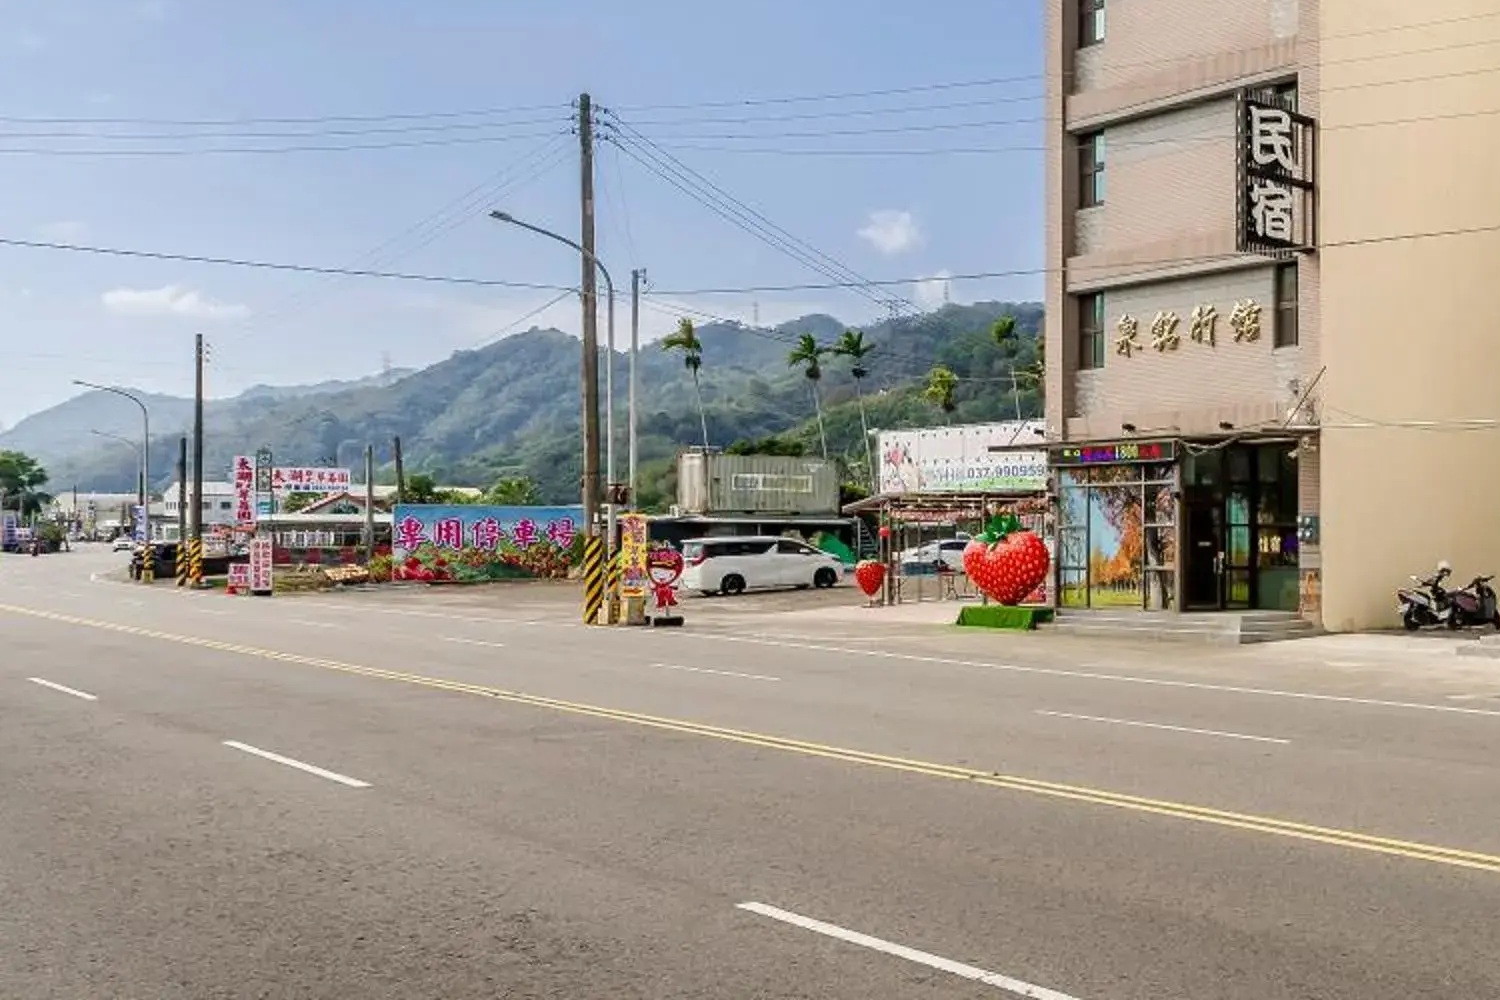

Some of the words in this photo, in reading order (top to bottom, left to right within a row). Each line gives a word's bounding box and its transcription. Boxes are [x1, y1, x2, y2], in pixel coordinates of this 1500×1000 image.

[1250, 105, 1296, 241] 民宿
[394, 514, 578, 551] 專用停車場
